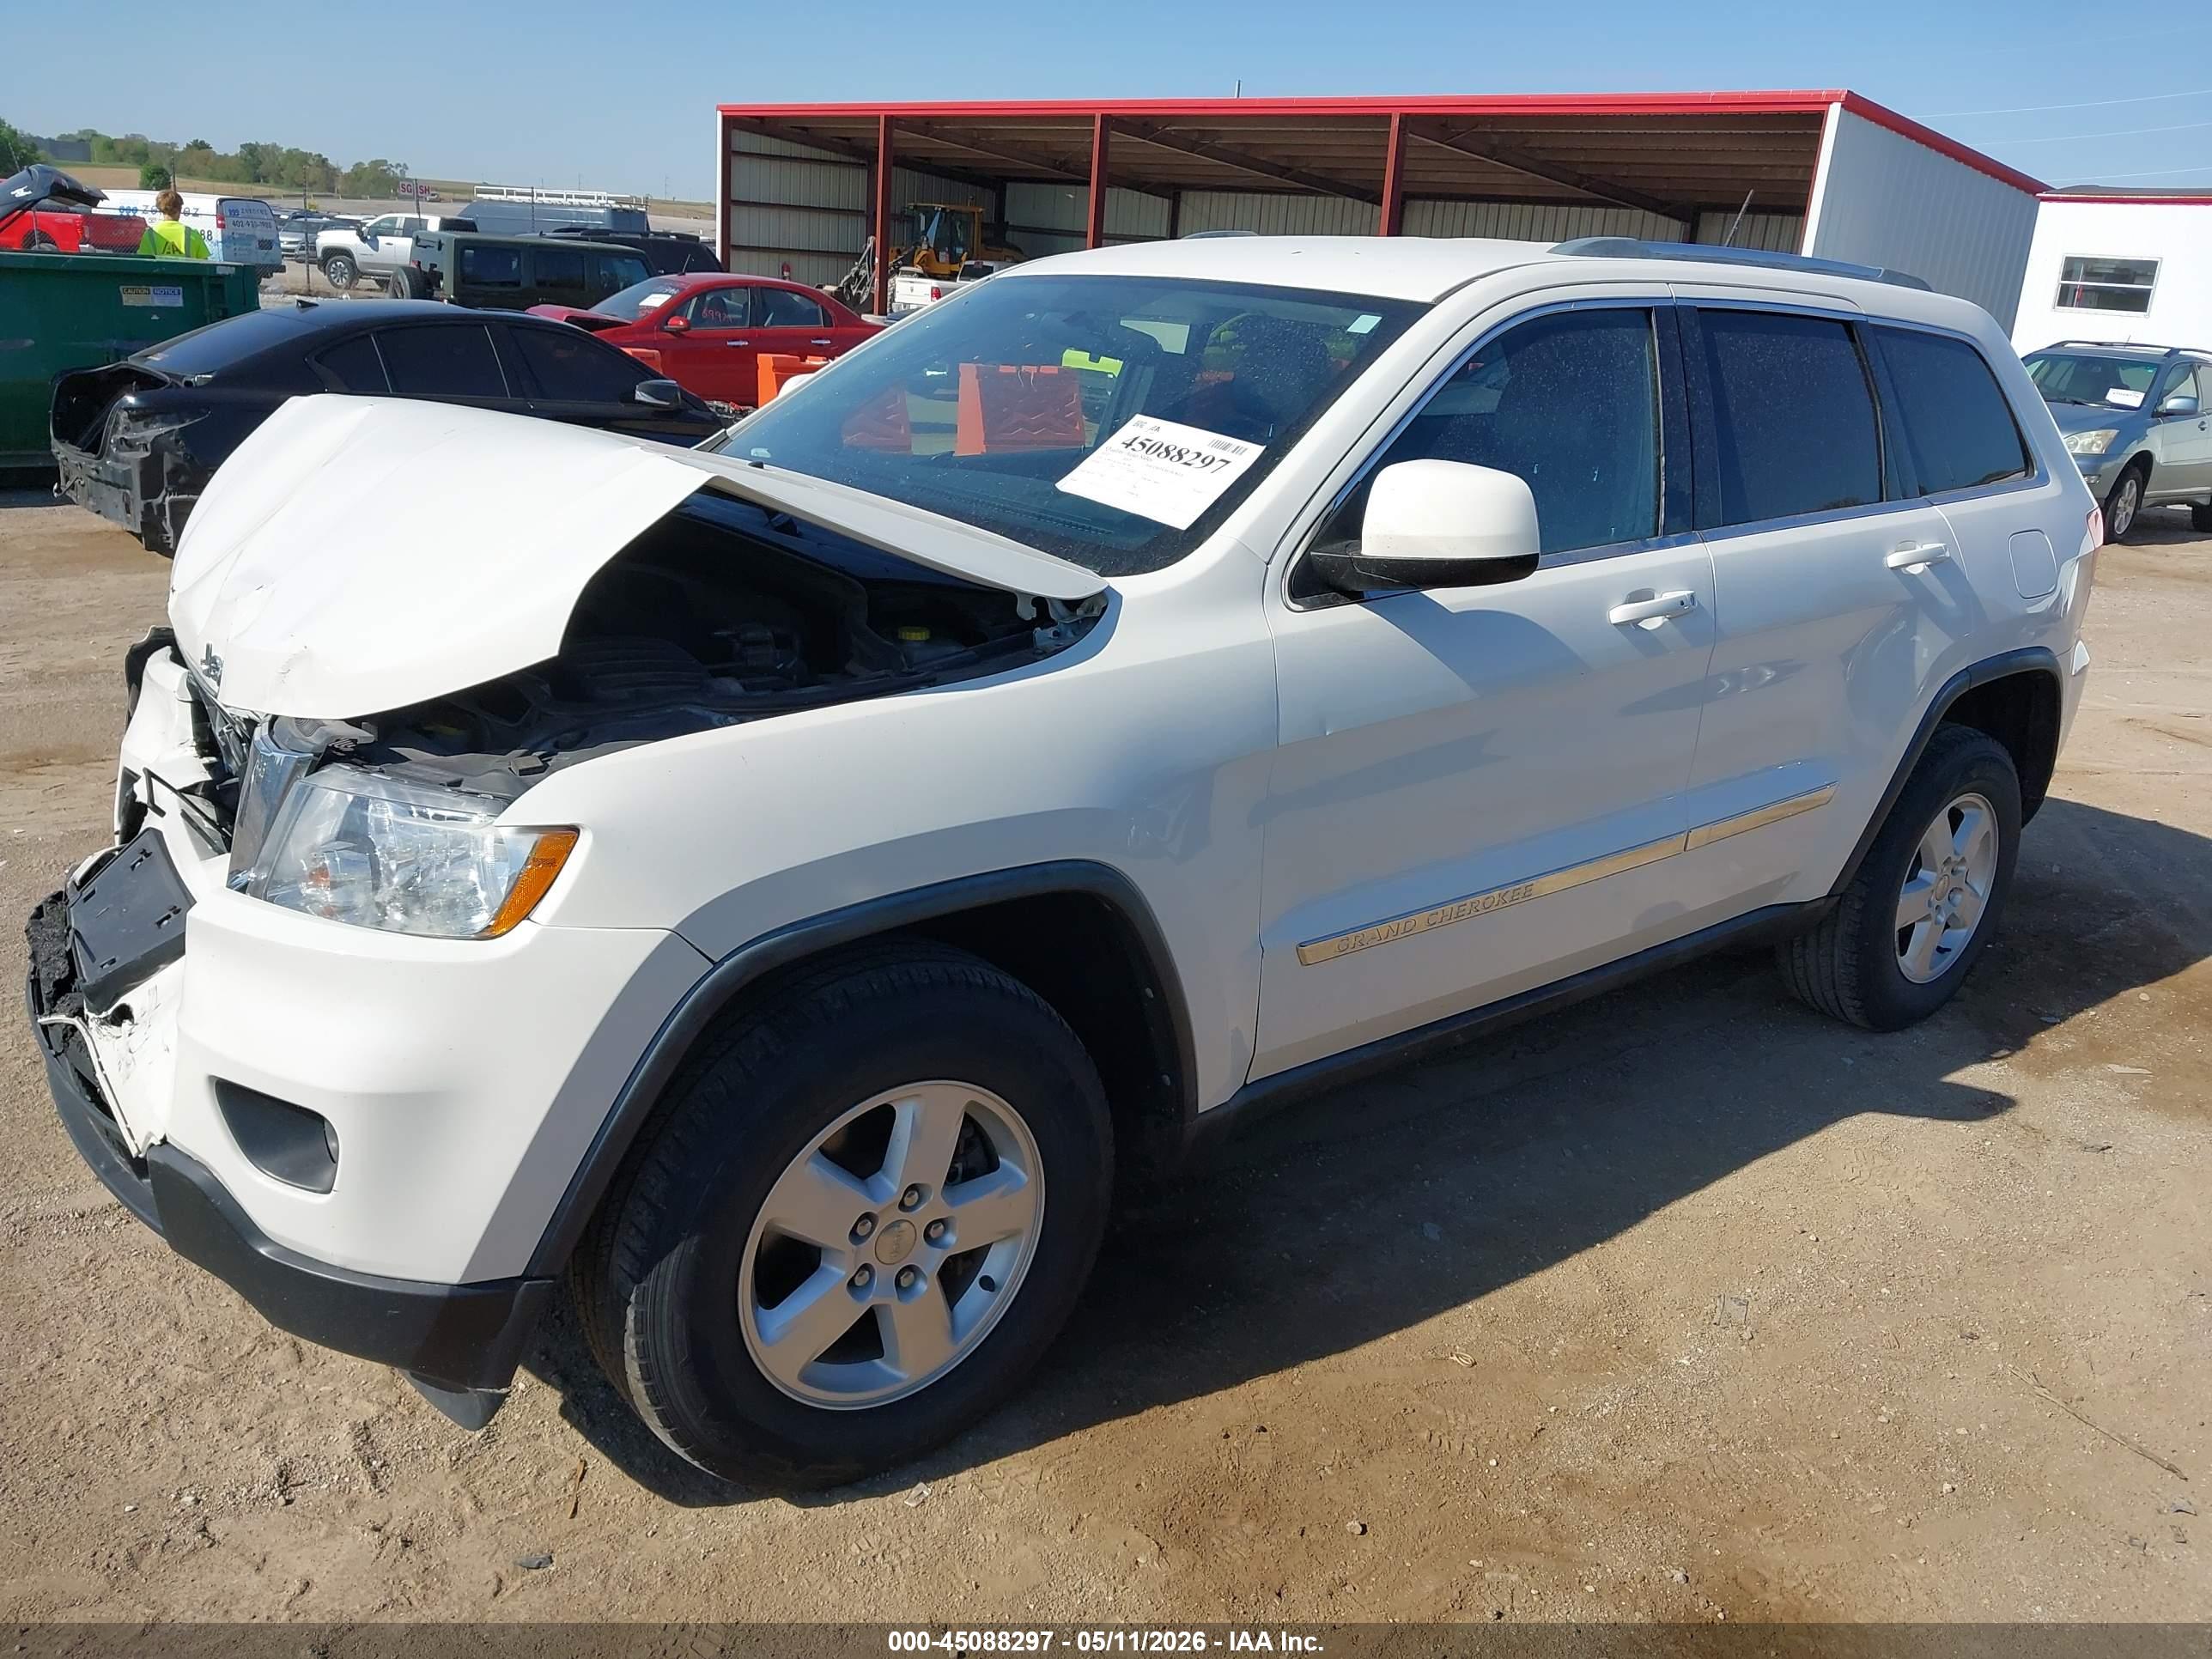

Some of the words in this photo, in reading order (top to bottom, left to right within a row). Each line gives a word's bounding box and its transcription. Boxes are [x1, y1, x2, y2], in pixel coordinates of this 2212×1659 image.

[1121, 435, 1232, 474] 45088297
[1335, 918, 1417, 953] GRAND
[1425, 883, 1534, 927] CHEROKEE
